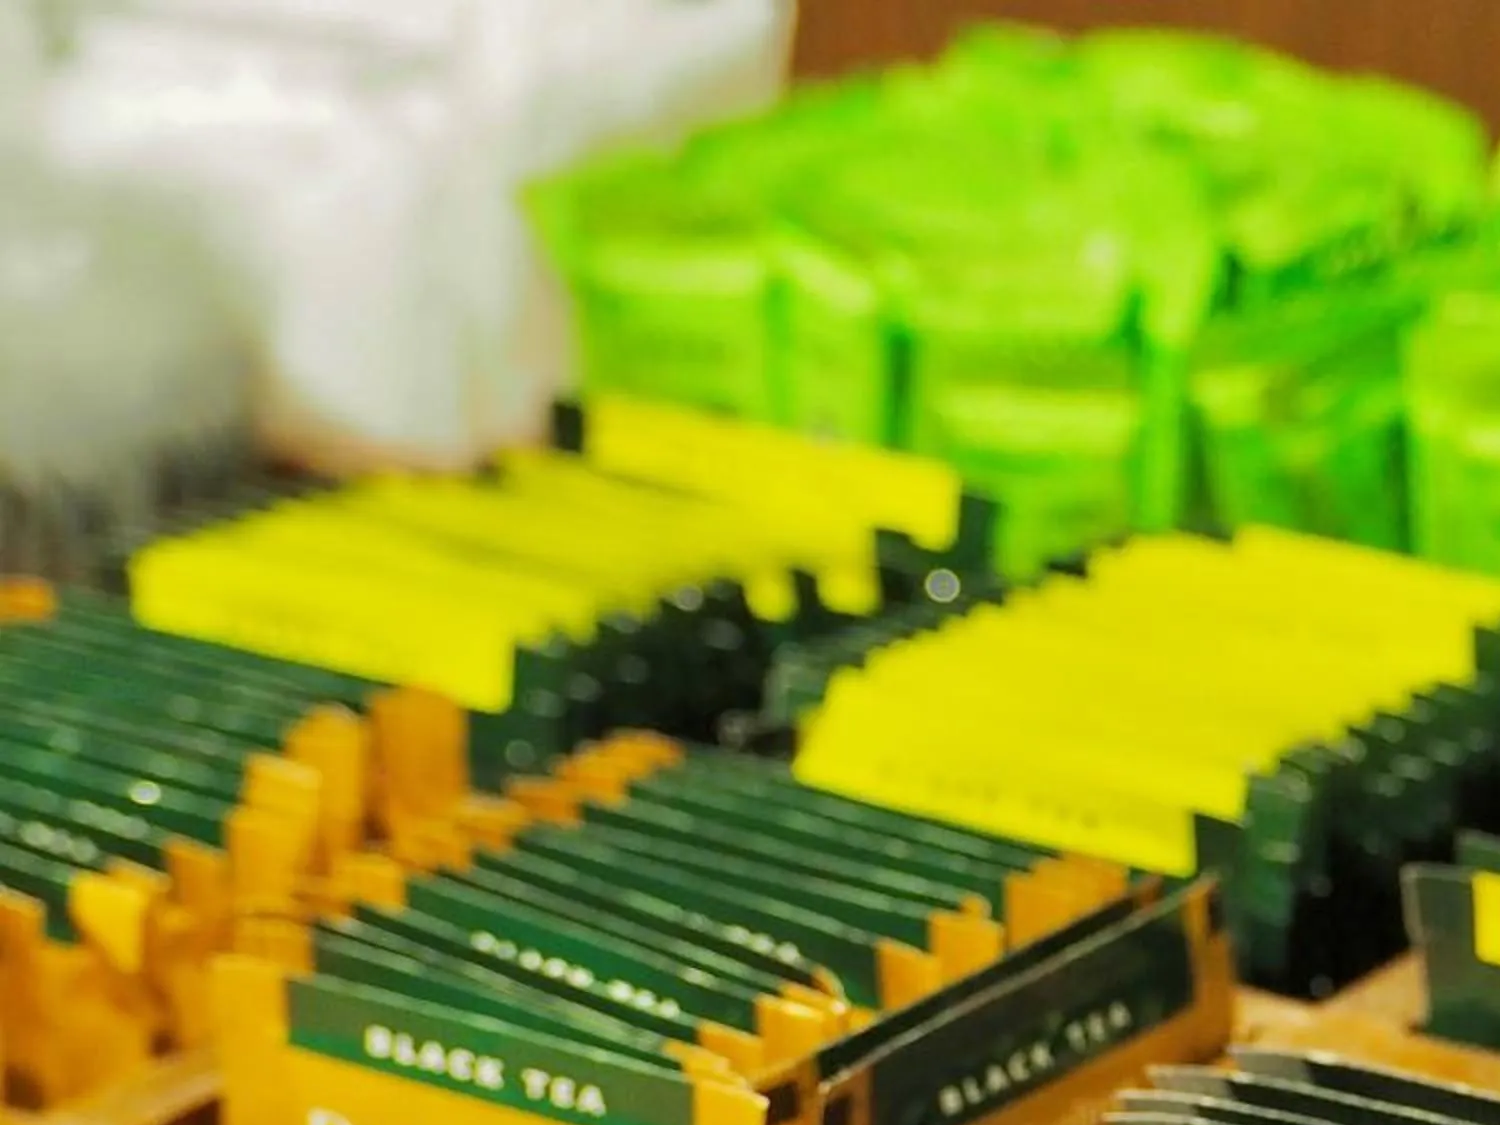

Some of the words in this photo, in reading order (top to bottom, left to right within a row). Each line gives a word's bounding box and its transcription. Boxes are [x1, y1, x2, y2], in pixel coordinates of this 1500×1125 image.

[364, 1024, 505, 1091] BLACK
[521, 1067, 608, 1118] TEA
[938, 1040, 1054, 1117] BLACK
